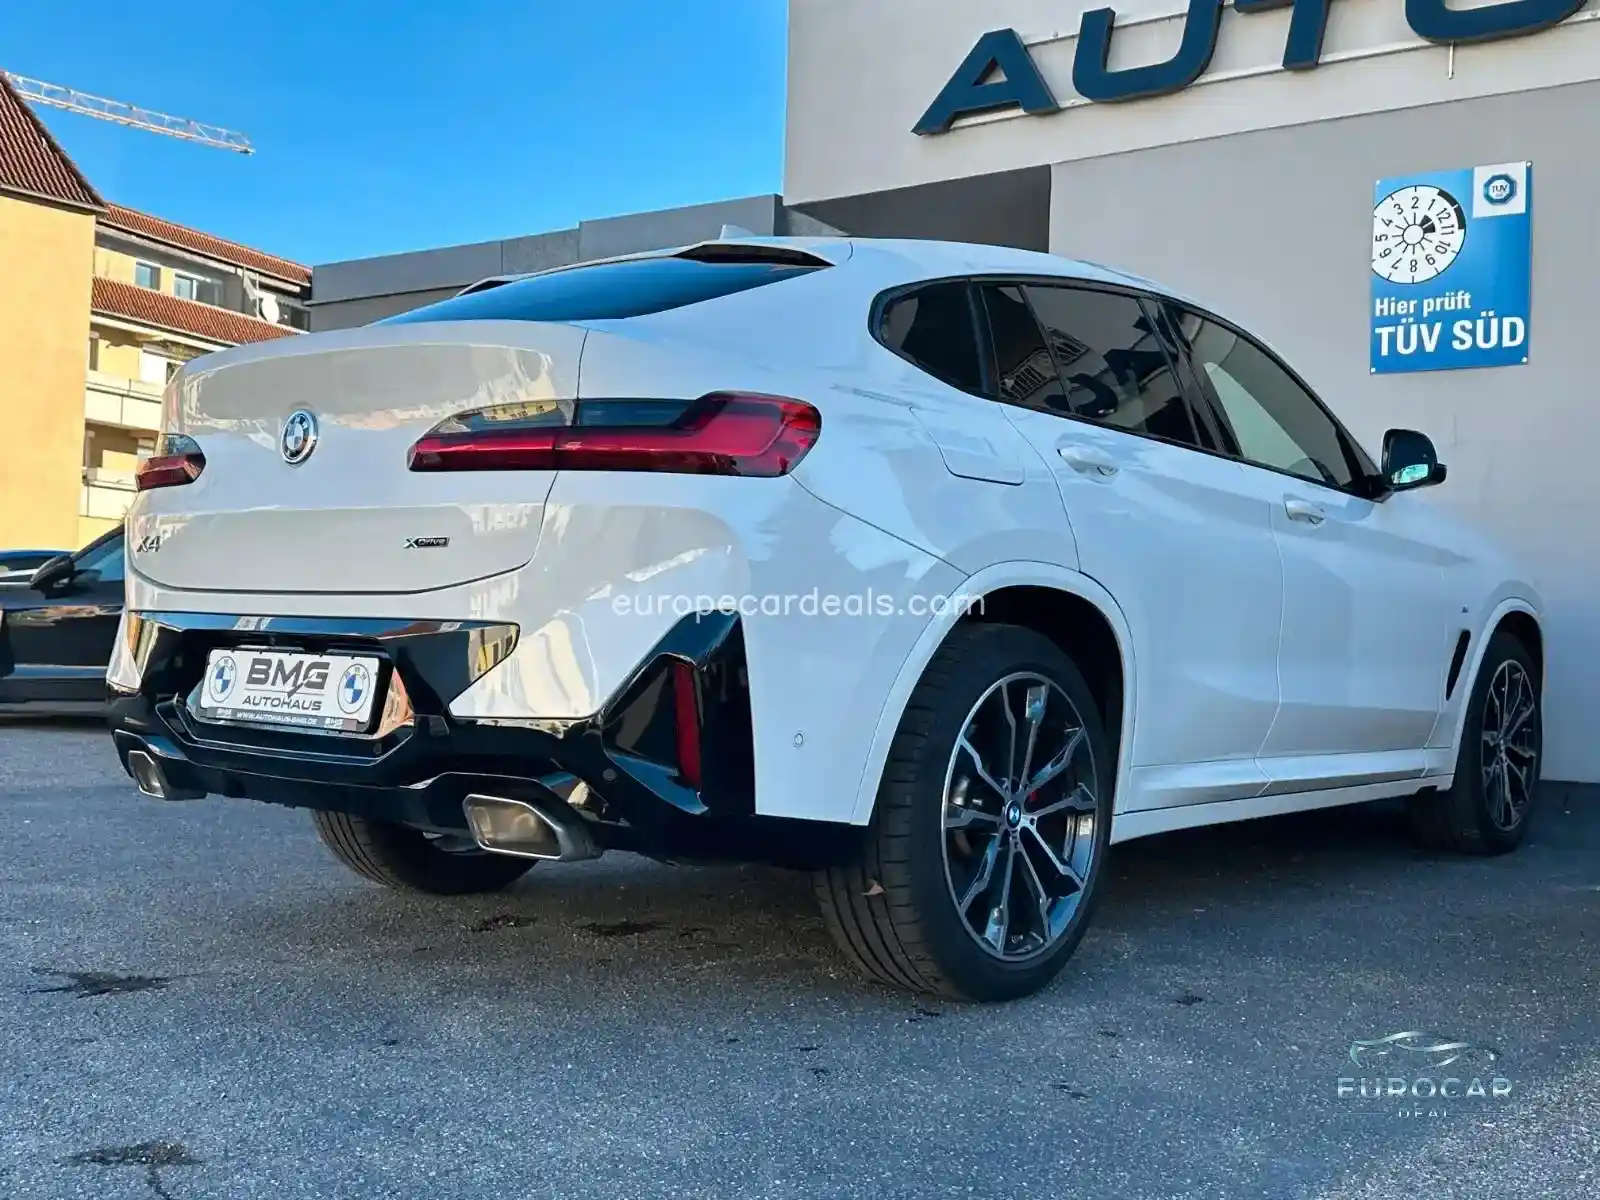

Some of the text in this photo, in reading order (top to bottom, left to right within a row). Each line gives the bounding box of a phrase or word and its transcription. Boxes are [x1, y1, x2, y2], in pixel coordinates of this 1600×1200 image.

[1410, 195, 1420, 210] 2
[1409, 258, 1418, 273] 8
[1374, 290, 1472, 318] Hier prüft
[1374, 310, 1526, 357] TÜV SÜD
[136, 535, 160, 553] X4
[246, 657, 331, 693] BMG
[241, 695, 323, 711] AUTOHAUS
